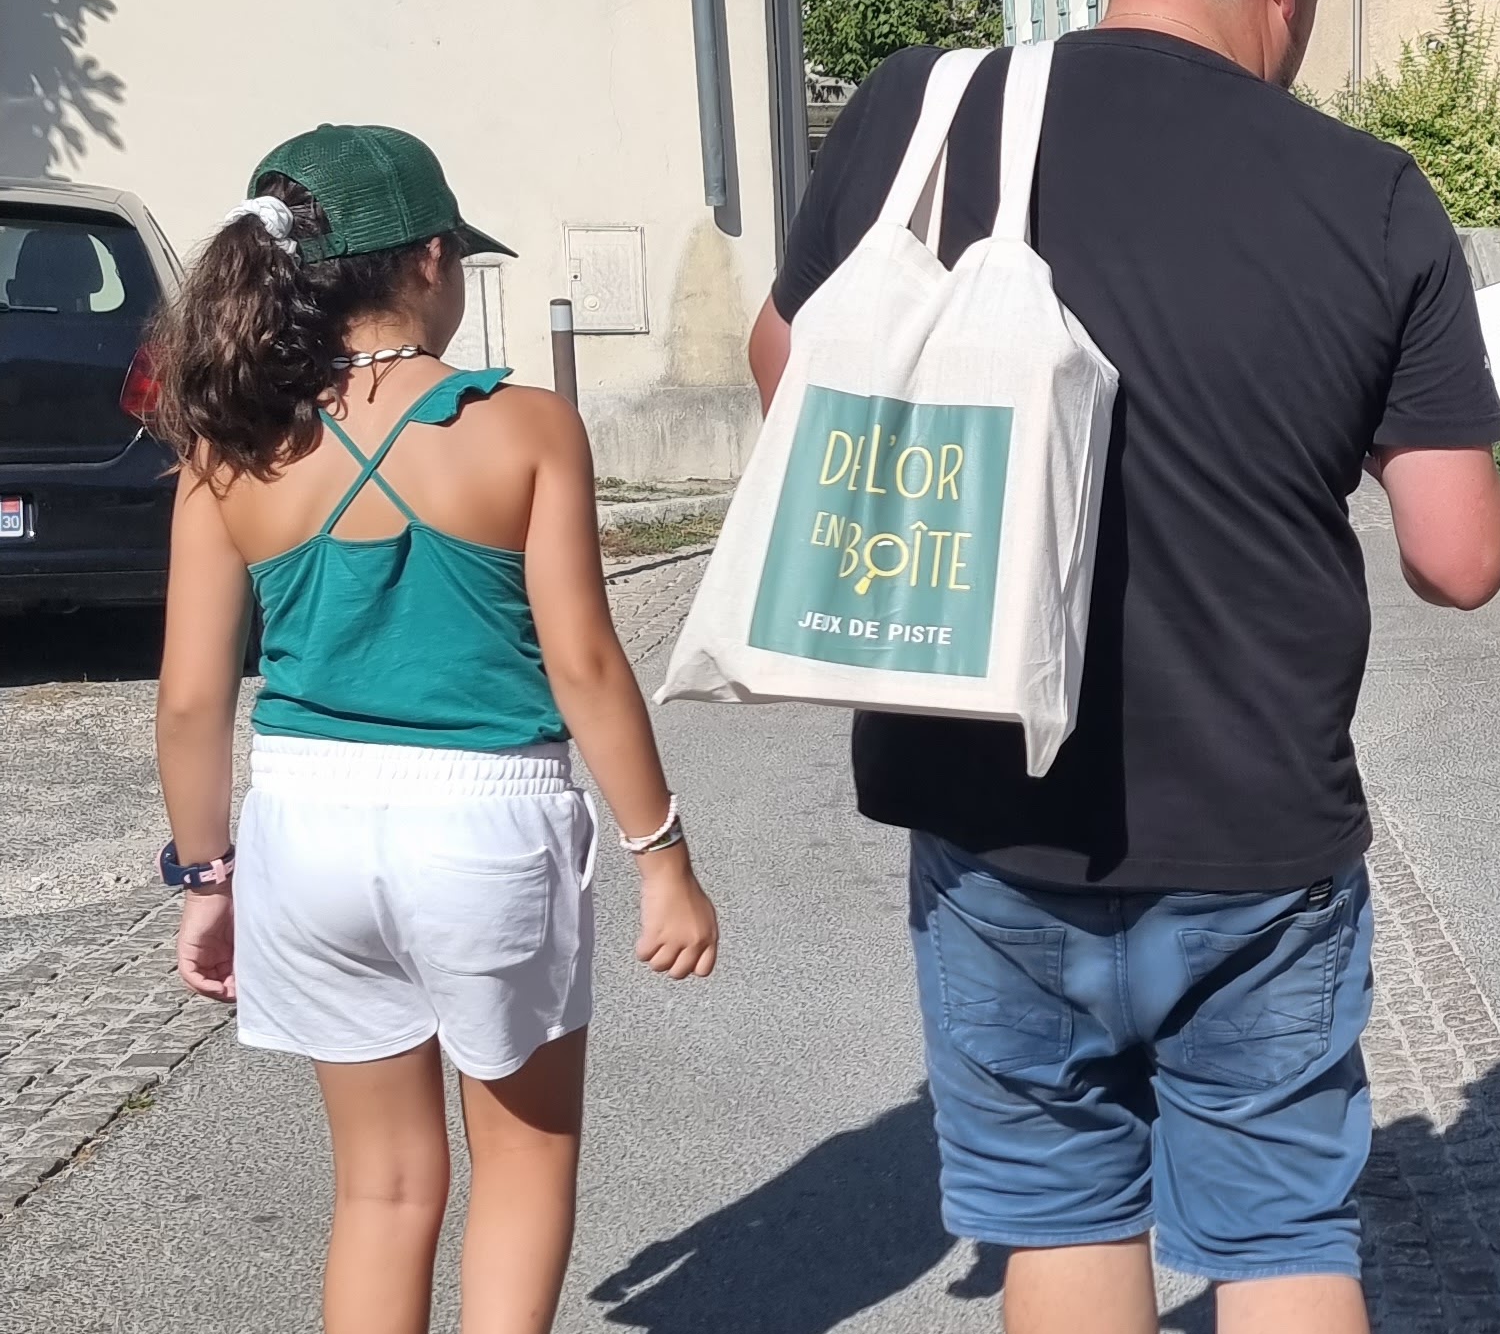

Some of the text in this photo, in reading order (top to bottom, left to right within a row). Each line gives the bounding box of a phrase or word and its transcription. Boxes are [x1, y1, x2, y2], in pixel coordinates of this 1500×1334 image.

[2, 515, 20, 529] 30
[810, 511, 846, 548] EN
[848, 618, 881, 640] DE
[887, 623, 953, 645] PISTE
